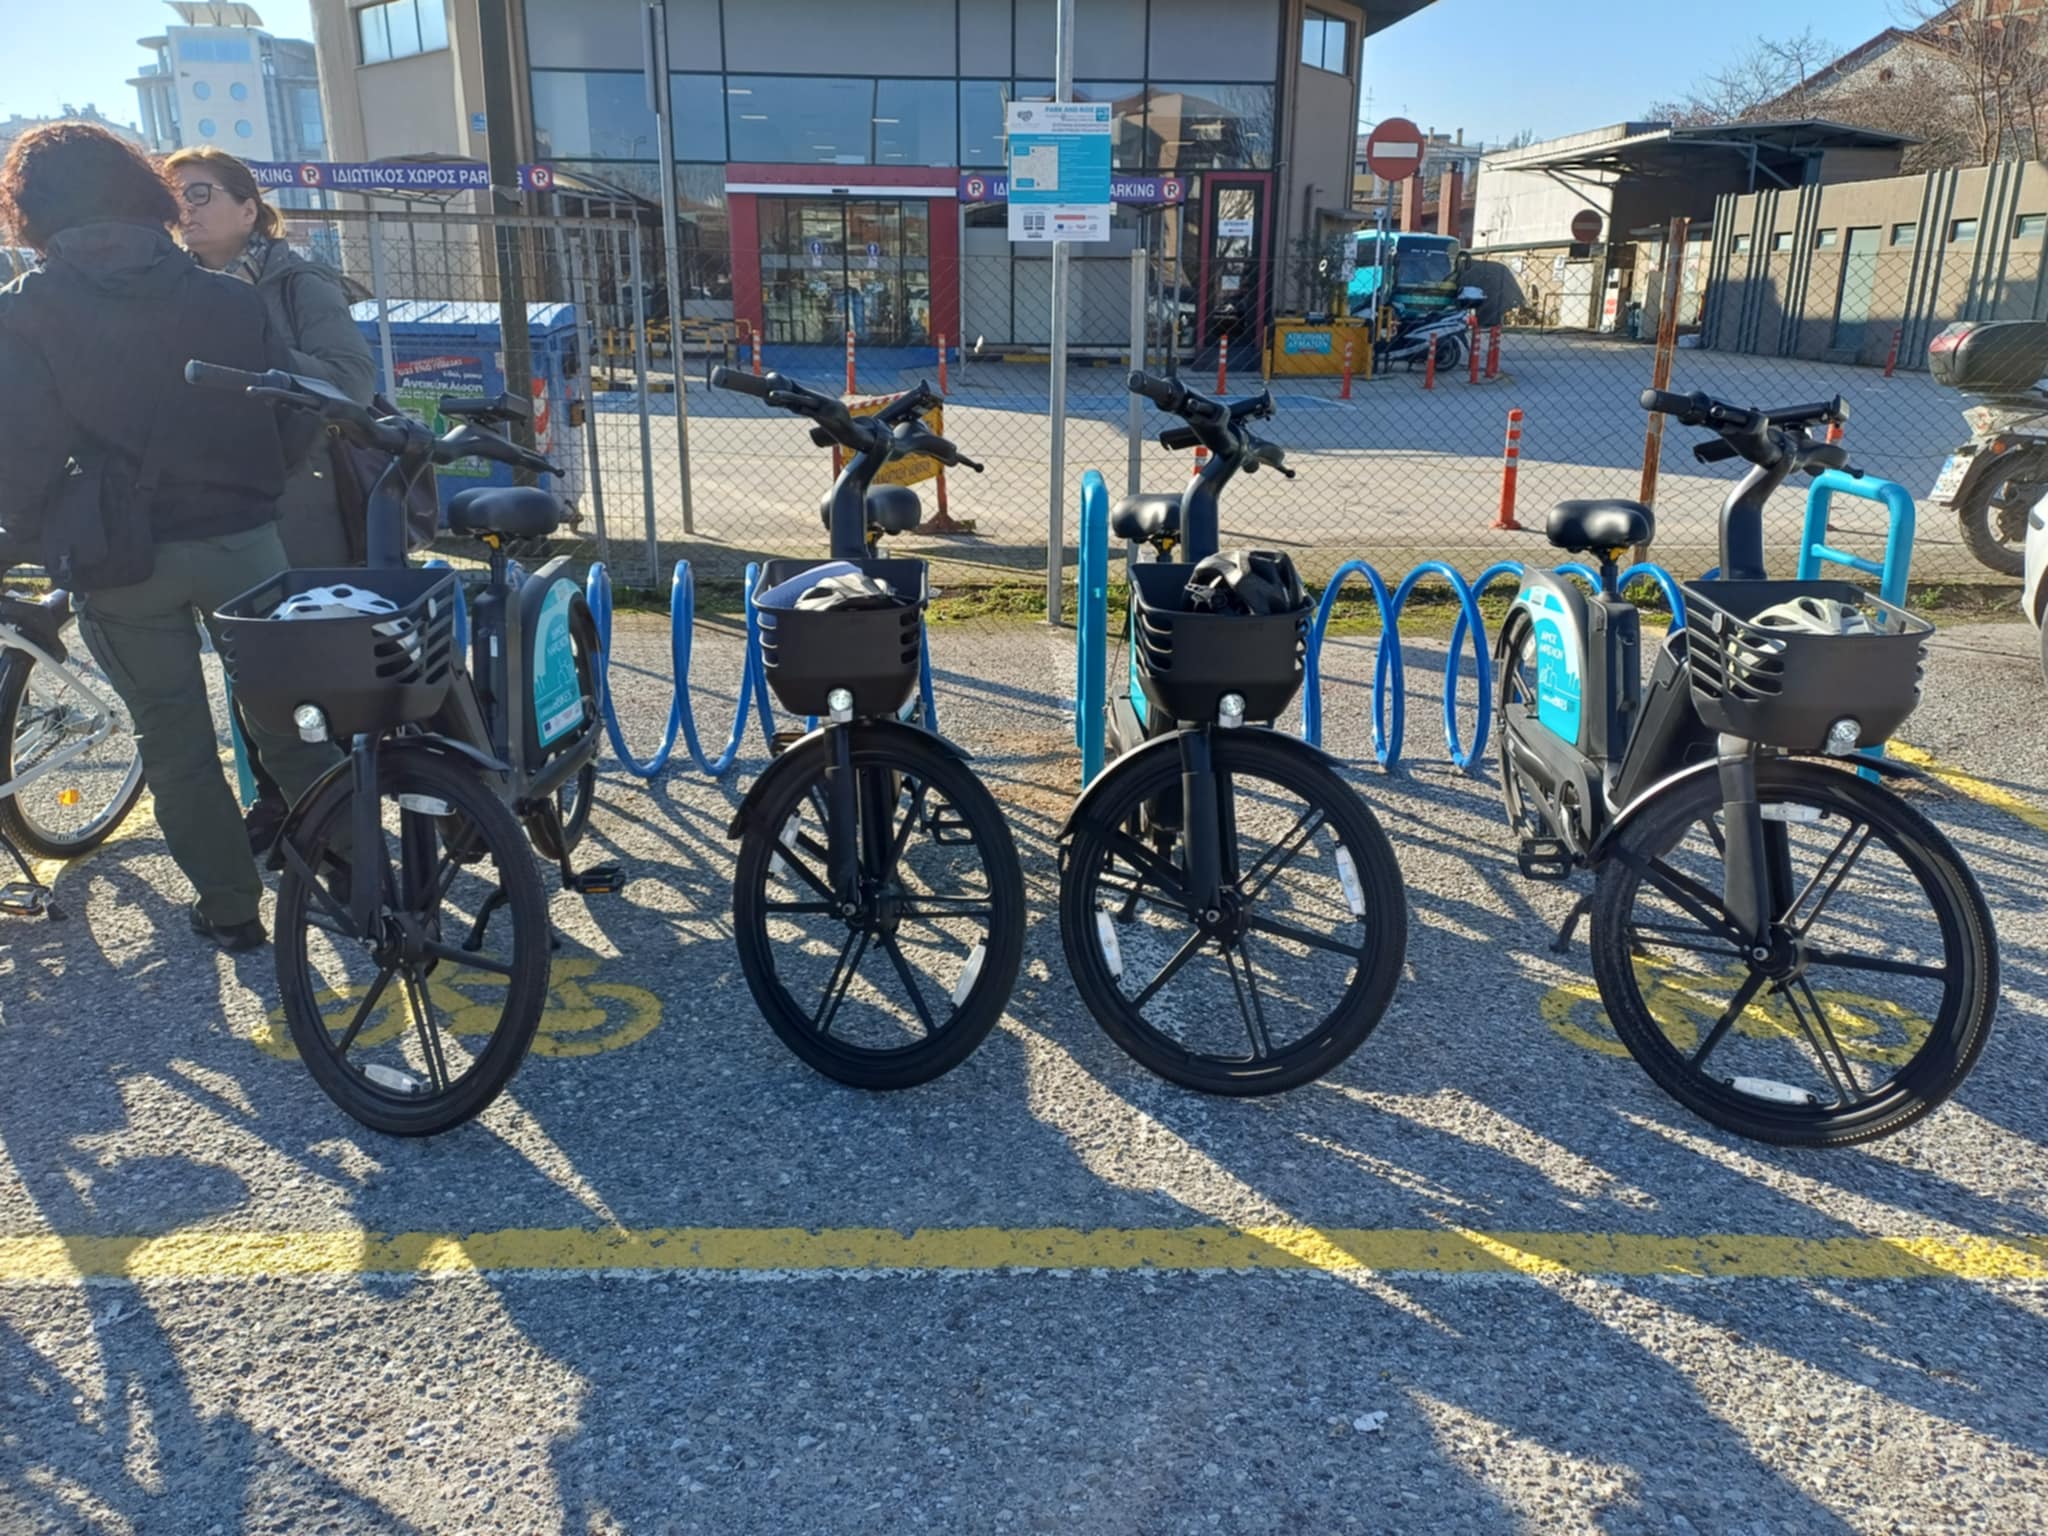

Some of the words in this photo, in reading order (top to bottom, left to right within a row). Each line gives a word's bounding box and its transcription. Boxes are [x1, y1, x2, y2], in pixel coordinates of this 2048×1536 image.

[250, 168, 293, 183] RKING
[332, 168, 405, 184] ΙΔΙΩΤΙΚΟΣ
[408, 169, 457, 184] ΧΩΡΟΣ
[459, 169, 489, 184] PAR
[1110, 183, 1154, 197] ARKING
